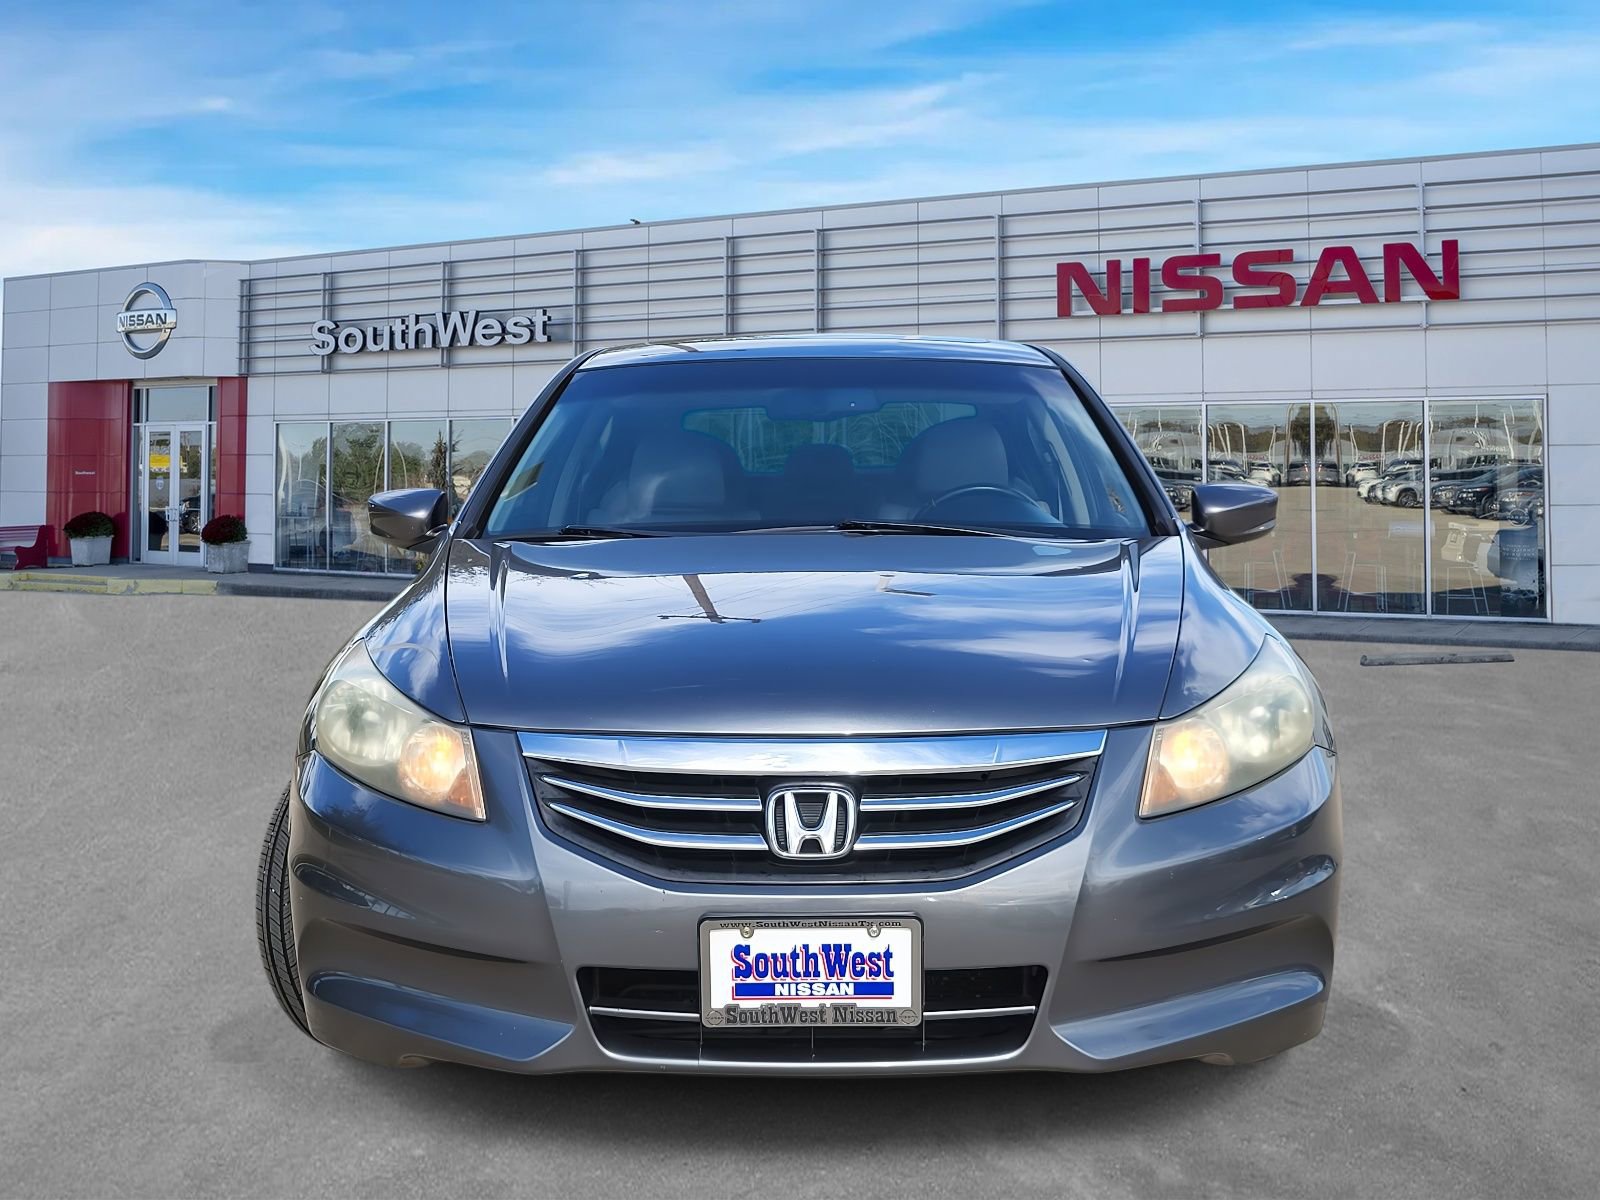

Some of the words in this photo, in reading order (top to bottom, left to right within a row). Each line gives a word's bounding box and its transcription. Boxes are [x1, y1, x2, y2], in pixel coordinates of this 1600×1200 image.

[1056, 239, 1461, 318] NISSAN
[119, 312, 167, 328] NISSAN
[309, 309, 552, 356] SouthWest
[731, 943, 895, 981] SouthWest
[774, 983, 855, 996] NISSAN
[726, 1005, 827, 1025] SouthWest
[833, 1005, 899, 1024] Nissan
